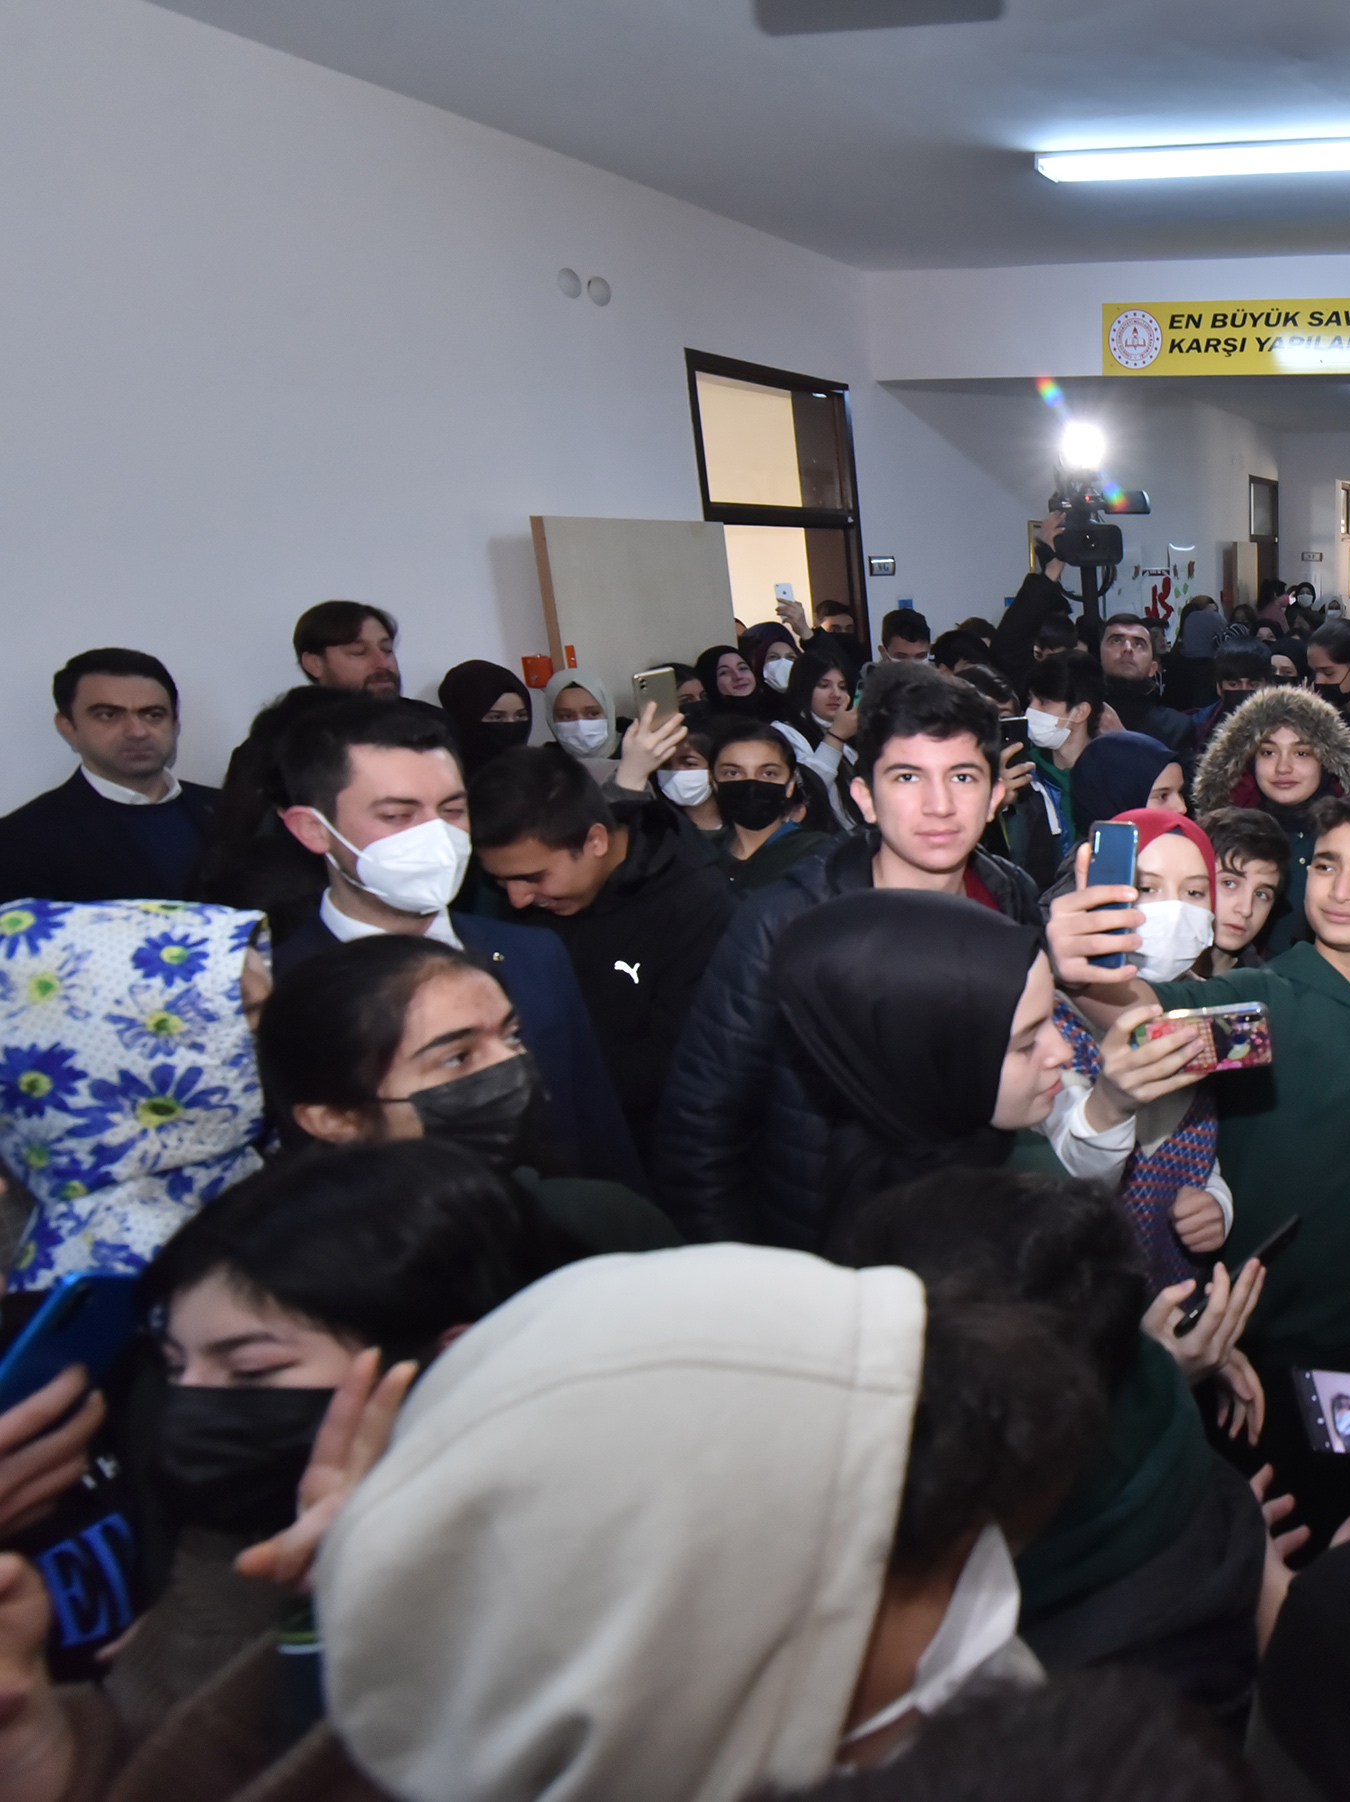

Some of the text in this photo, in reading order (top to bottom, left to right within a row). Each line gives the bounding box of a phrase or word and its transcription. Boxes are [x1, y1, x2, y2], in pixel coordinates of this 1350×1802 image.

[1168, 314, 1203, 330] EN
[1210, 307, 1300, 329] BÜYÜK
[1168, 337, 1247, 358] KARŞI
